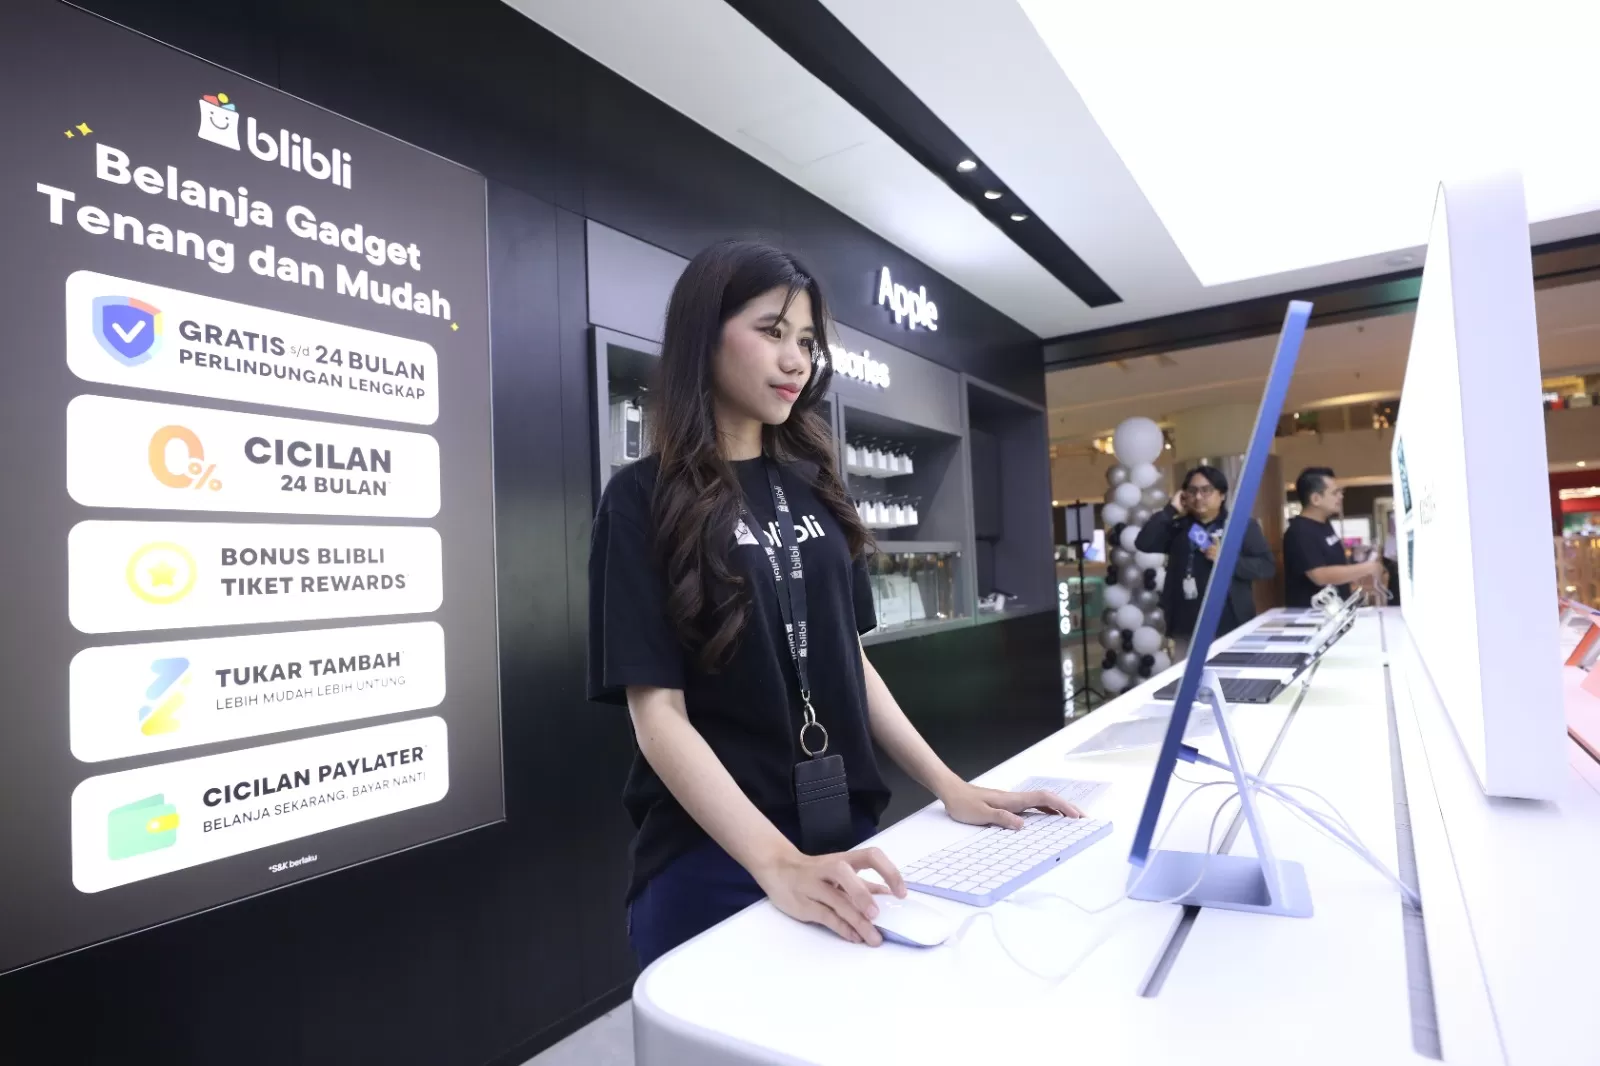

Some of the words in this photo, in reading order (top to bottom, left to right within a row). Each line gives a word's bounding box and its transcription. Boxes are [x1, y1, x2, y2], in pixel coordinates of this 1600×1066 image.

[248, 117, 351, 189] blibli
[97, 143, 272, 228] Belanja
[286, 206, 420, 270] Gadget
[37, 183, 234, 273] Tenang
[249, 247, 324, 289] dan
[337, 264, 450, 320] Mudah
[879, 266, 938, 331] Apple
[179, 320, 285, 356] GRATIS
[291, 345, 309, 357] s/d
[315, 345, 343, 367] 24
[349, 351, 424, 381] BULAN
[180, 349, 342, 387] PERLINDUNGAN
[349, 377, 425, 399] LENGKAP
[148, 424, 223, 492] 0%
[245, 437, 391, 473] CICILAN
[281, 475, 307, 491] 24
[314, 477, 386, 496] BULAN
[773, 485, 787, 505] blibli
[222, 548, 309, 566] BONUS
[318, 548, 384, 564] BLIBLI
[768, 556, 783, 582] blibli
[789, 545, 802, 570] blibli
[221, 577, 293, 596] TIKET
[301, 574, 405, 592] REWARDS
[1058, 582, 1071, 634] SKG
[798, 620, 807, 647] blibli
[216, 662, 301, 687] TUKAR
[309, 652, 400, 676] TAMBAH
[217, 695, 257, 710] LEBIH
[264, 689, 312, 703] MUDAH
[318, 684, 352, 696] LEBIH
[357, 676, 405, 690] UNTUNG
[203, 769, 310, 807] CICILAN
[319, 747, 423, 782] PAYLATER
[204, 808, 270, 832] BELANJA
[353, 780, 389, 796] BAYAR
[393, 772, 425, 786] NANTI
[289, 854, 318, 868] berlaku
